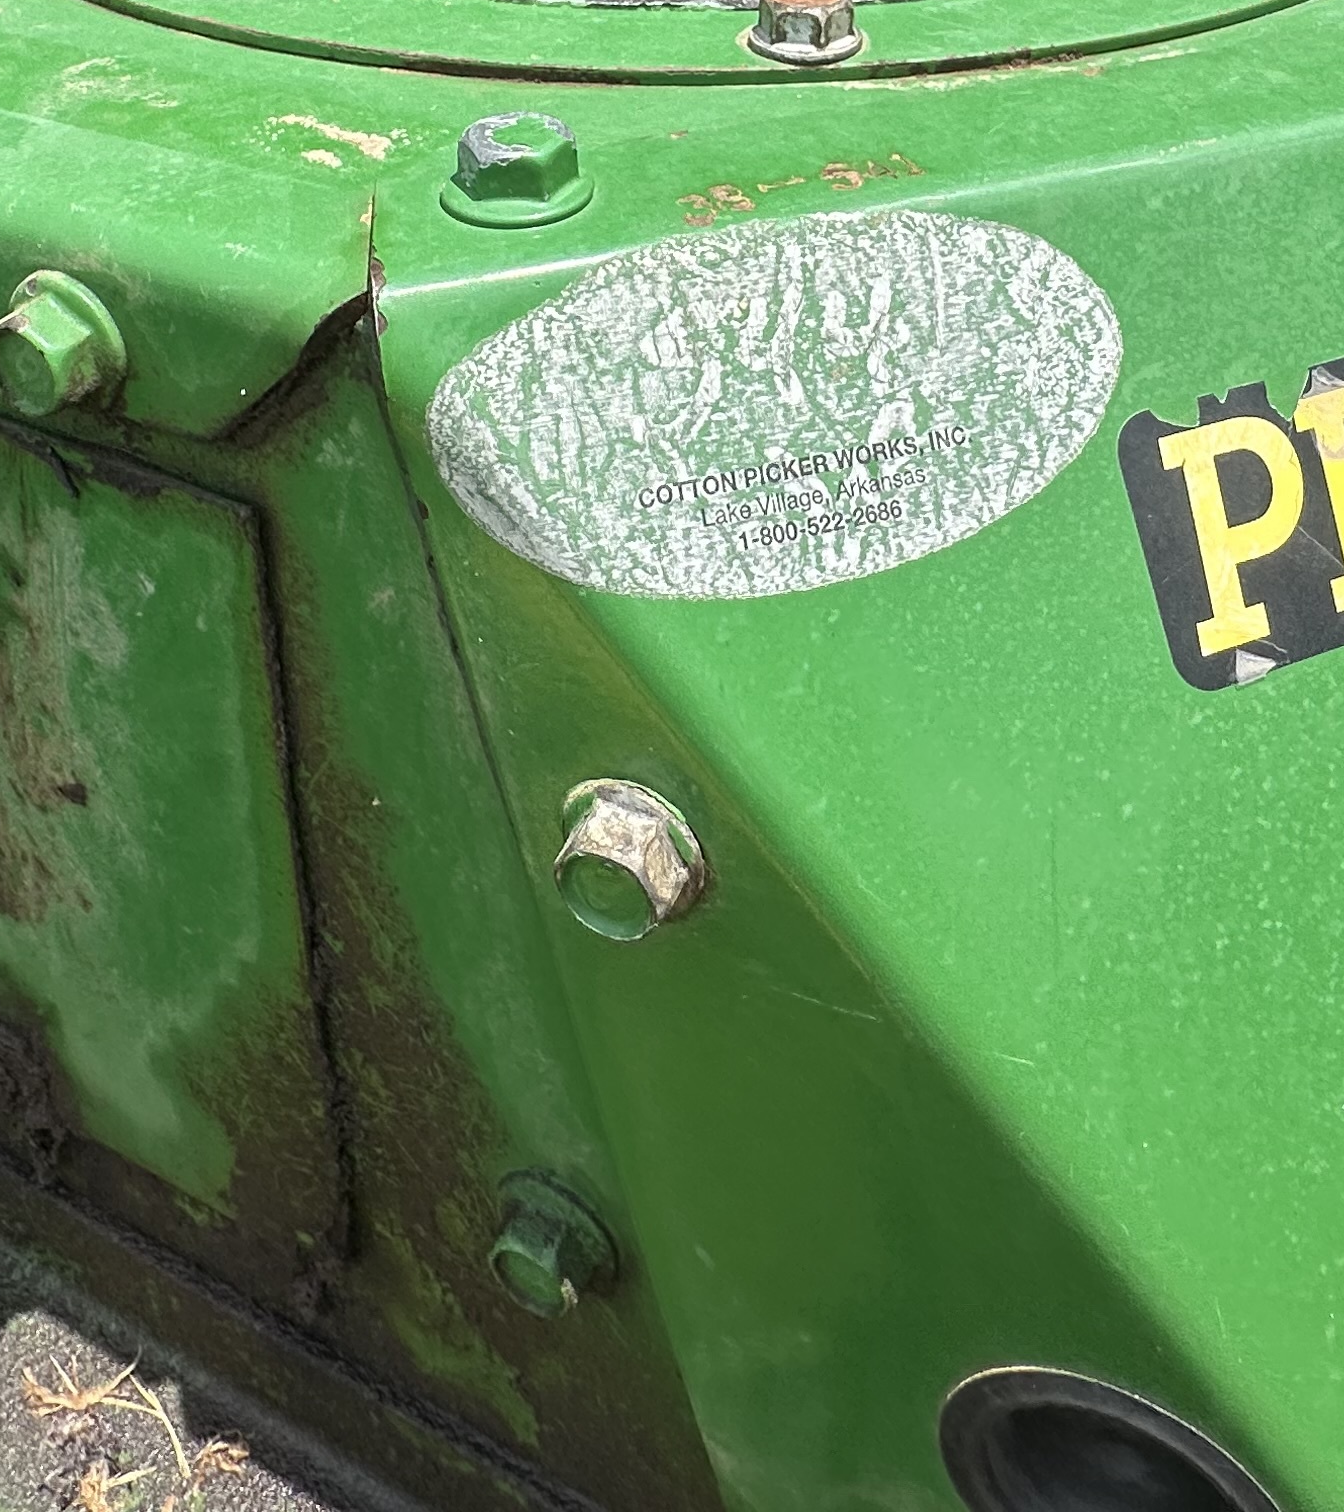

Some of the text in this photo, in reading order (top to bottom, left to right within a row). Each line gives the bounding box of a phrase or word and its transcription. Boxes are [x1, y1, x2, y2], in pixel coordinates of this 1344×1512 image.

[638, 426, 973, 509] COTTON PICKER WORKS, INC.
[701, 467, 927, 527] Lake Village, Arkansas
[738, 499, 903, 550] 1-800-522-2686
